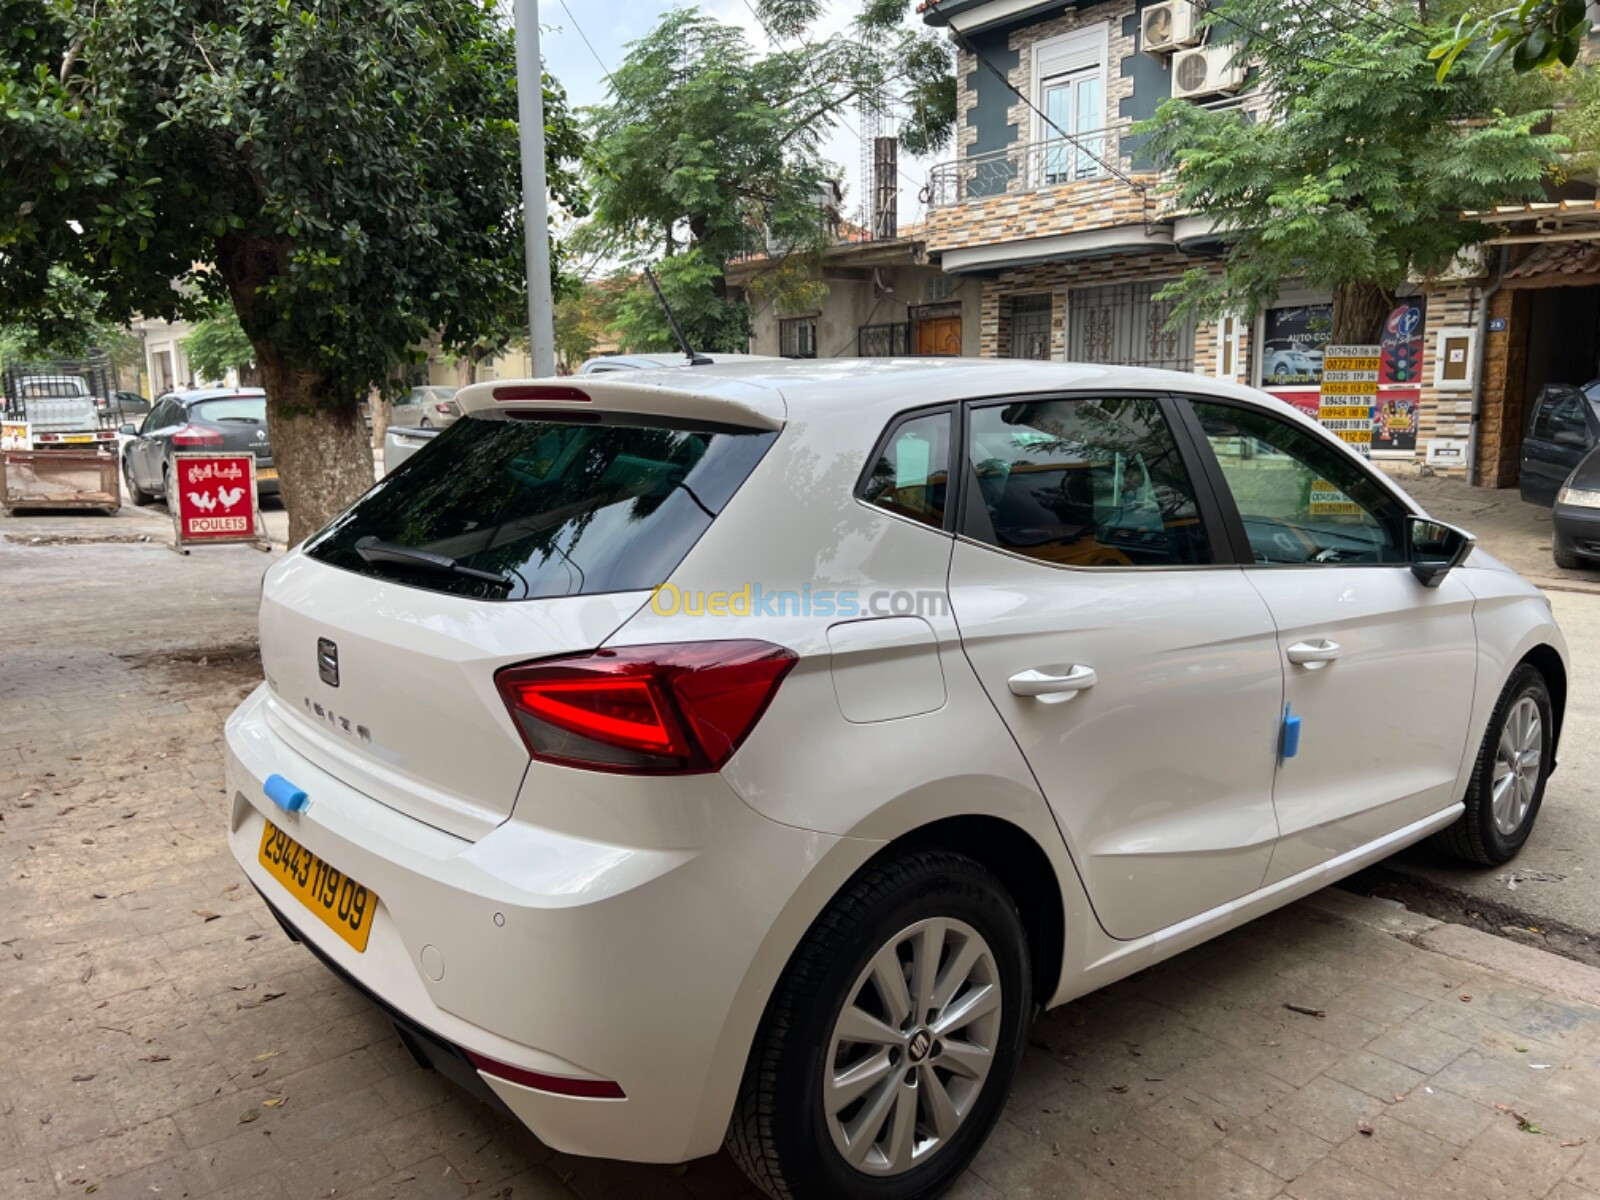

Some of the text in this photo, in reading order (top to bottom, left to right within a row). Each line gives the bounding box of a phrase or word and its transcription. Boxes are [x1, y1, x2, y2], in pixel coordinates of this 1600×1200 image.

[1287, 333, 1312, 342] AUTO
[1355, 359, 1365, 369] 119
[191, 518, 245, 531] POULETS
[304, 697, 371, 743] IBIZA
[264, 820, 367, 931] 29443 119 09
